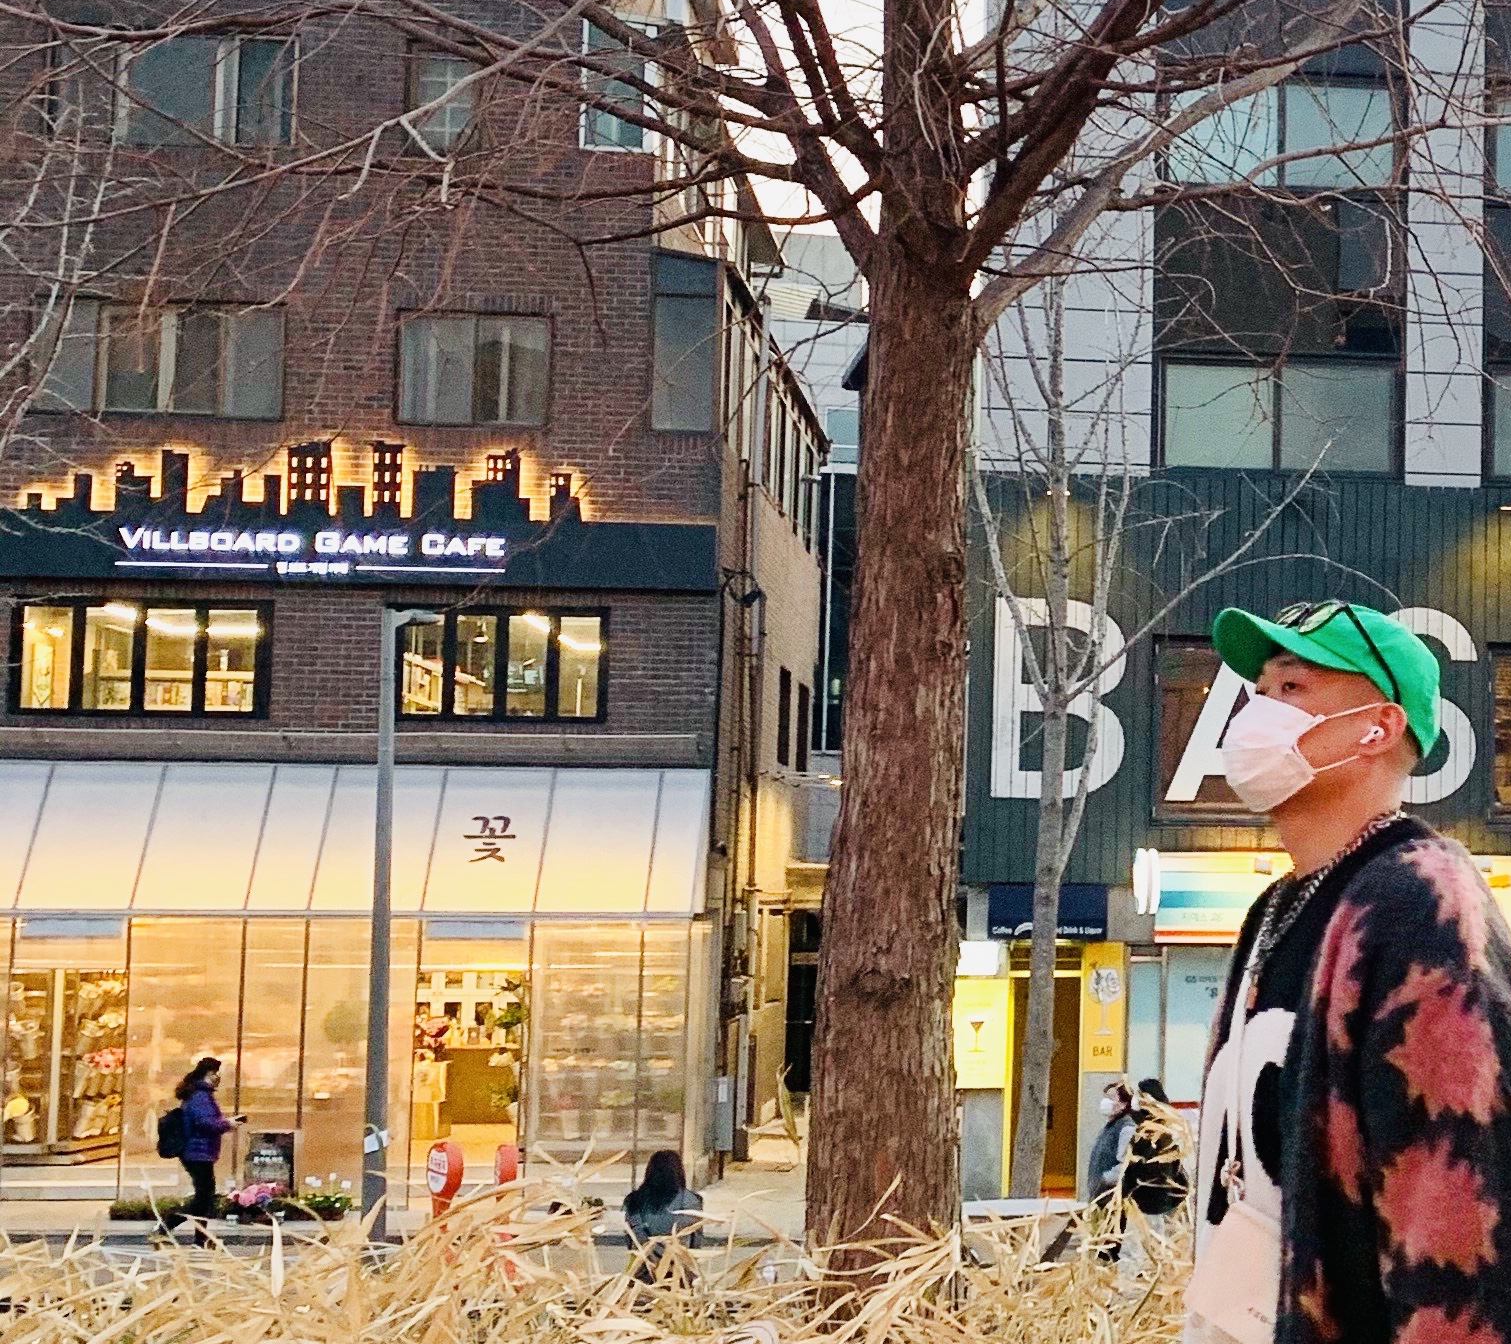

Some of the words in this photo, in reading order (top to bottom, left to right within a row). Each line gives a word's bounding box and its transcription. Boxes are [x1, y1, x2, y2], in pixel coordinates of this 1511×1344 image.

[314, 531, 409, 555] GAME
[421, 533, 505, 557] CAFE
[463, 814, 516, 863] 꽃
[1092, 1046, 1113, 1057] BAR
